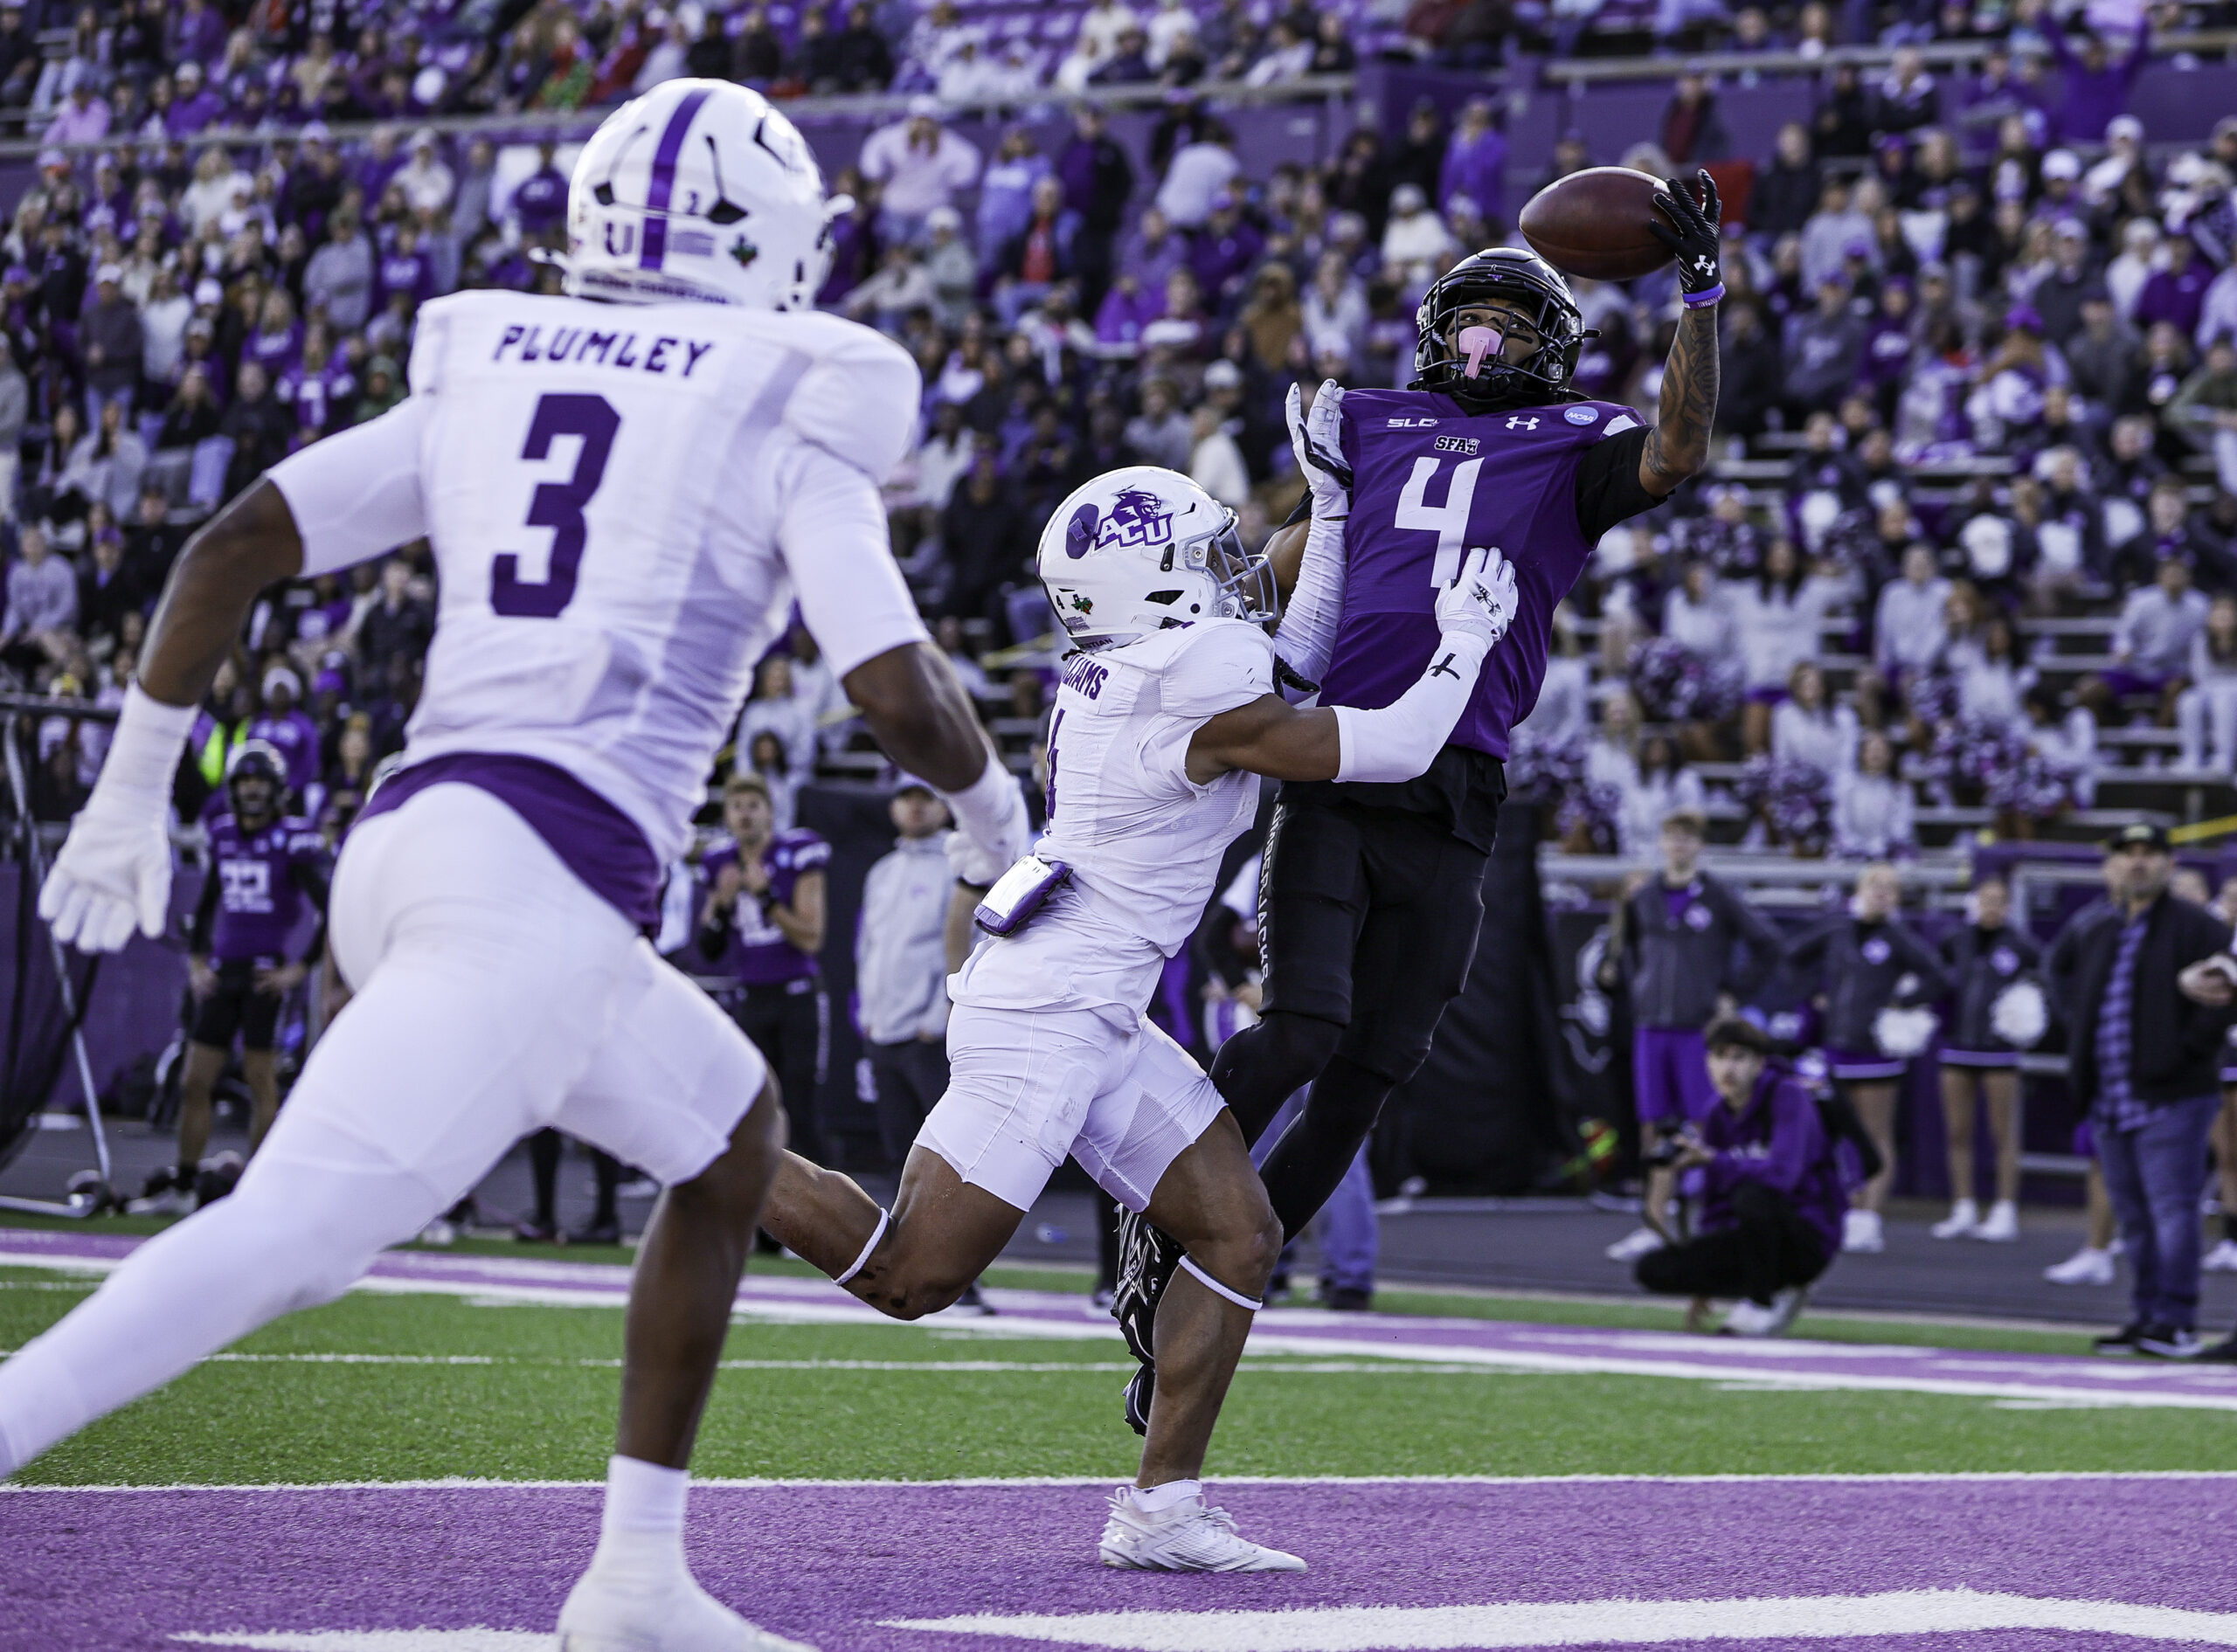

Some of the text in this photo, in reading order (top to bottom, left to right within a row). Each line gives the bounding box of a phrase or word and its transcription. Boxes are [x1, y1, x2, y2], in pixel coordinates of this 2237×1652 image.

[493, 327, 713, 377] PLUMLEY
[1387, 418, 1437, 428] SLC
[1567, 411, 1595, 423] NCAA
[1434, 435, 1468, 453] SFA
[489, 393, 621, 619] 3
[1395, 456, 1486, 589] 4
[1094, 513, 1174, 551] ACU
